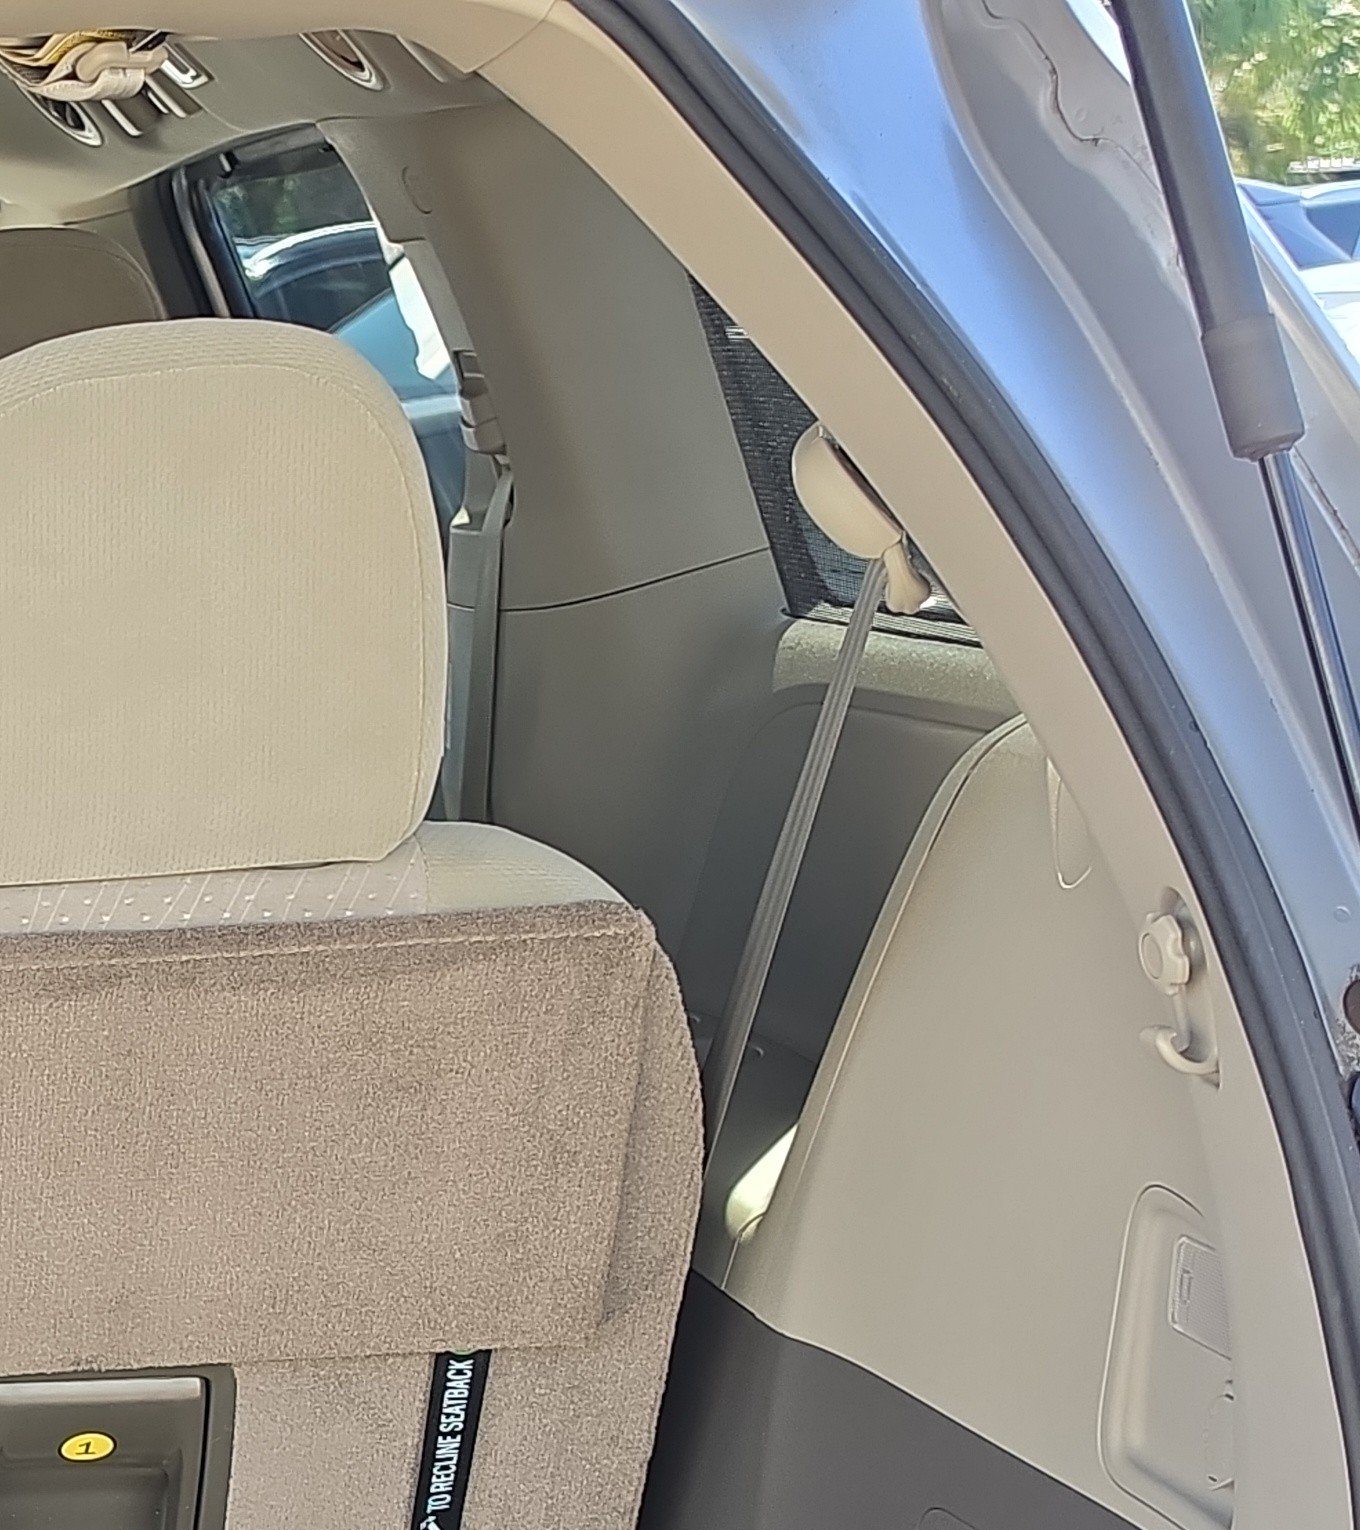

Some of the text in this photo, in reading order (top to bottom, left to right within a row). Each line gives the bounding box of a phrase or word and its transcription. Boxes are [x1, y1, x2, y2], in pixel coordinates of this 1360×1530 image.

[426, 1359, 474, 1514] TO RECLINE SEATBACK
